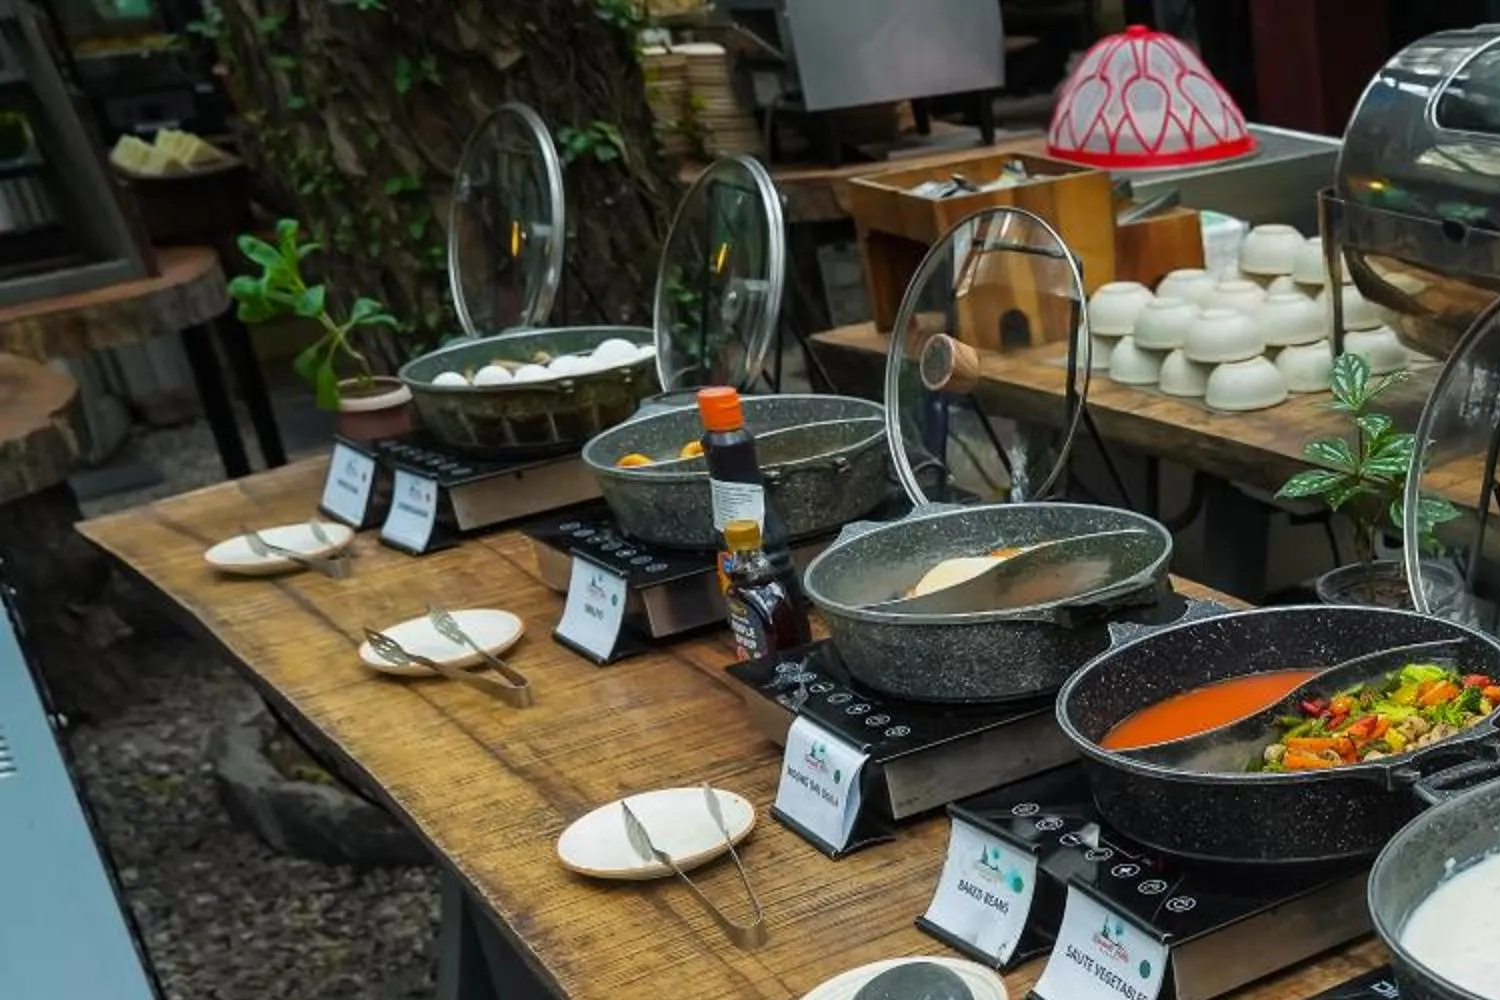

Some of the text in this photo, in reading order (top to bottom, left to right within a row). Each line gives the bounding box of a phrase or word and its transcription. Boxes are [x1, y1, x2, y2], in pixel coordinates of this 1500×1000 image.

[957, 879, 1010, 915] BAKED BEANS
[1065, 943, 1095, 973] SAUTE
